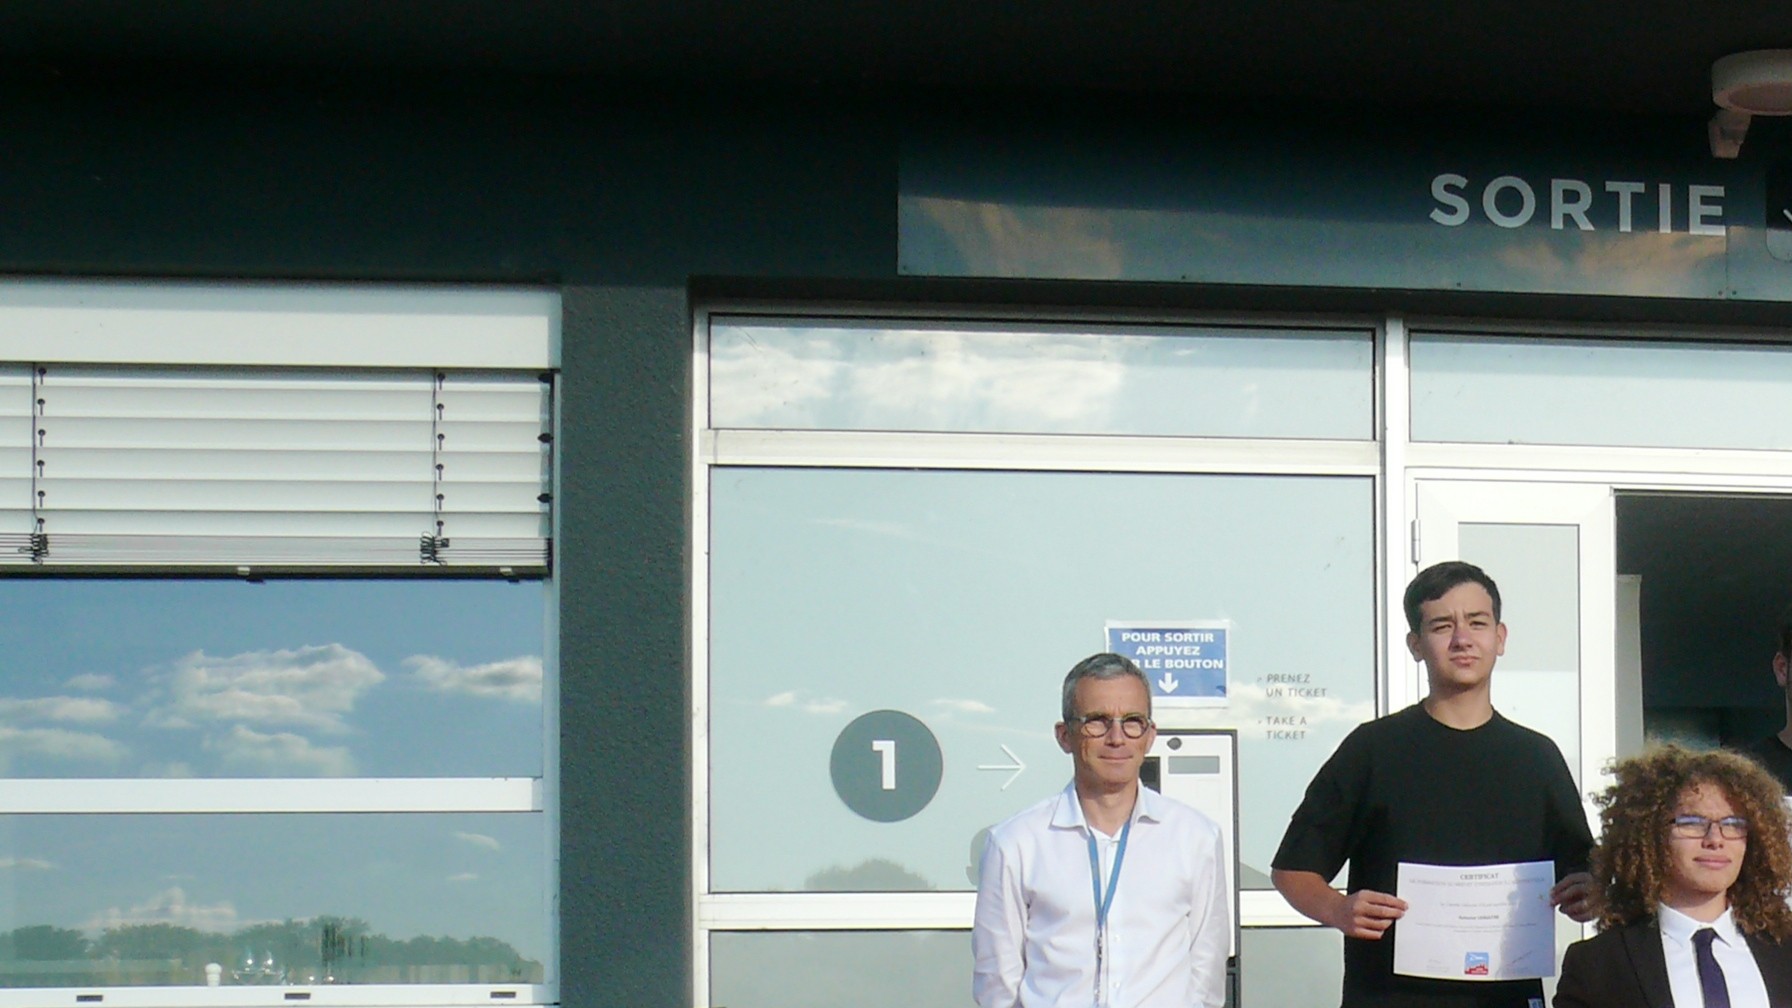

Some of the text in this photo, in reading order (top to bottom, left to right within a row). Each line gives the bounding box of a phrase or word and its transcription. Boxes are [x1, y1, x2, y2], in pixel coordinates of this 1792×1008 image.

[1430, 173, 1726, 237] SORTIE
[1121, 632, 1214, 643] POUR SORTIR
[1136, 646, 1200, 656] APPUYEZ
[1144, 659, 1161, 669] LE
[1165, 659, 1224, 669] BOUTON
[1266, 673, 1311, 684] PRENEZ
[1265, 688, 1327, 698] UN TICKET
[1266, 716, 1307, 725] TAKE A
[1266, 730, 1306, 740] TICKET
[871, 739, 896, 790] 1
